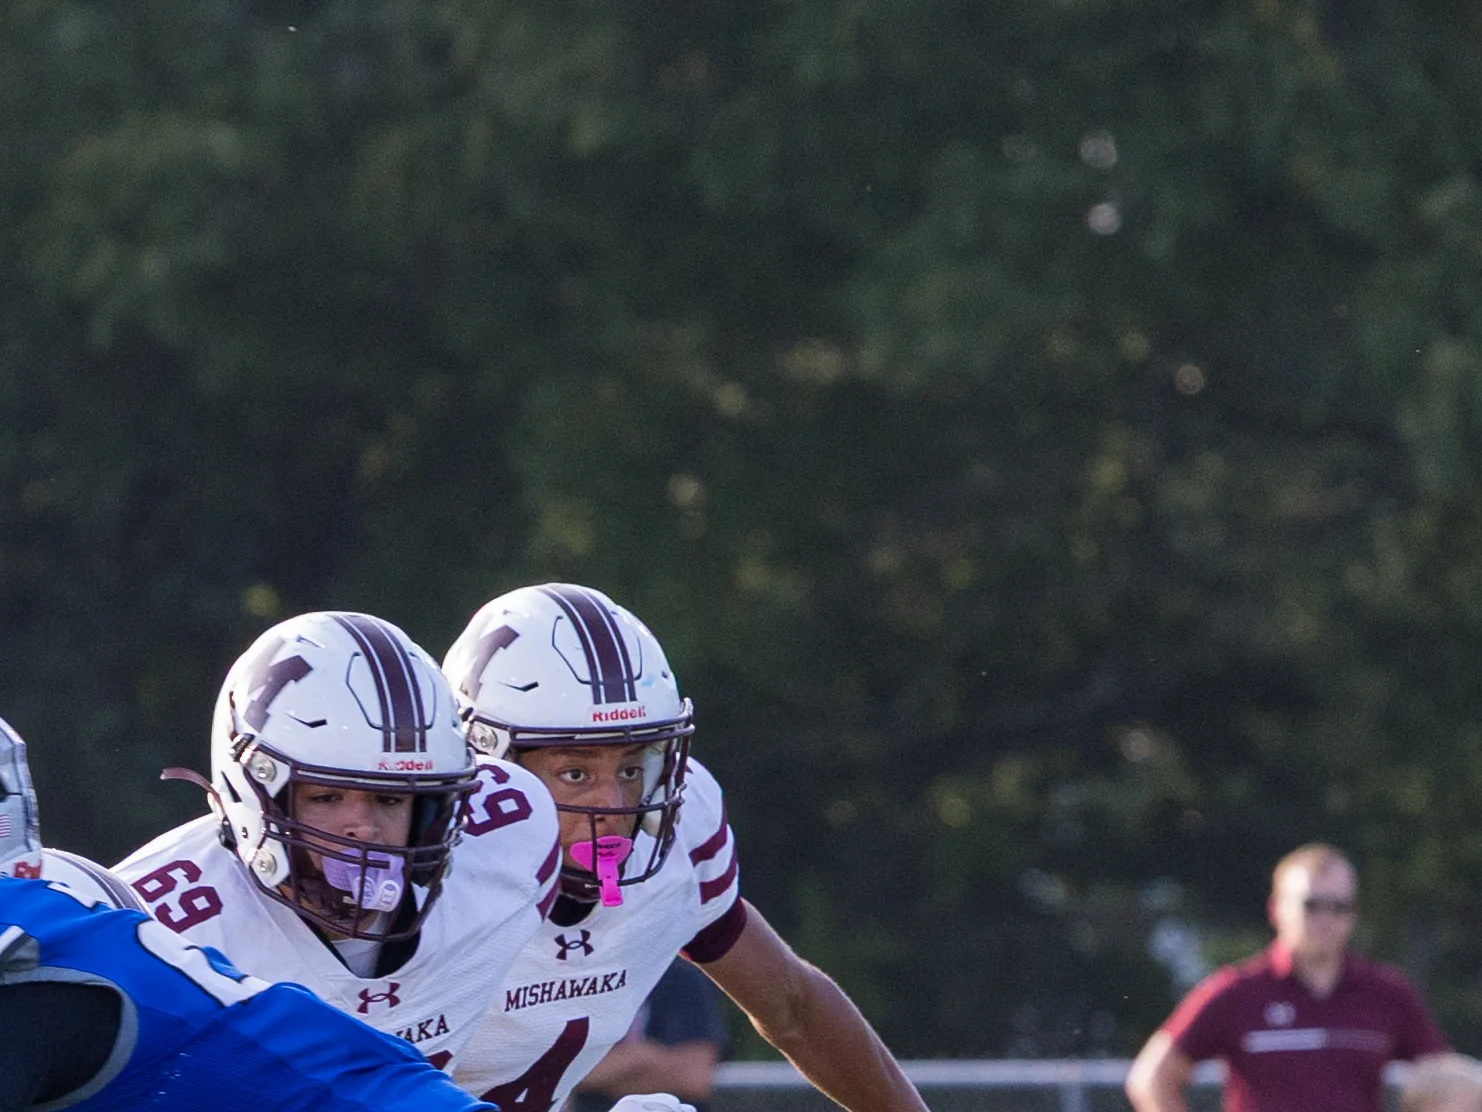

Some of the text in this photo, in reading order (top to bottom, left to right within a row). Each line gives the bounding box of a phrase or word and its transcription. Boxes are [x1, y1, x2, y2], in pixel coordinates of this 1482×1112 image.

[377, 759, 433, 771] Rddell
[130, 859, 224, 934] 69
[504, 969, 628, 1012] MISHAWAKA
